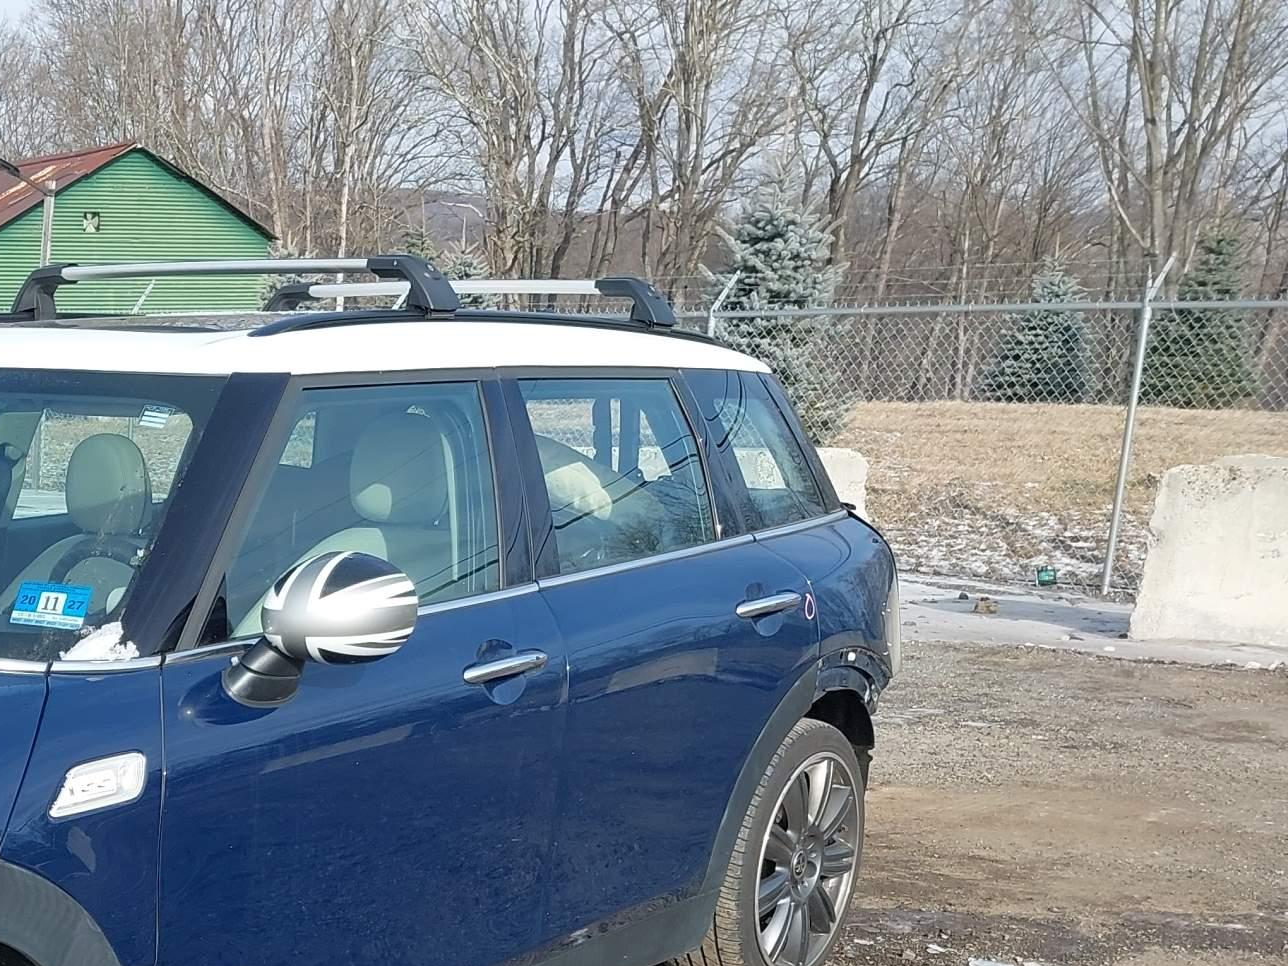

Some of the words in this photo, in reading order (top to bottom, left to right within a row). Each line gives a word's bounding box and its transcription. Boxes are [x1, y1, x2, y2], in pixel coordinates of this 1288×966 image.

[20, 594, 36, 605] 20
[41, 595, 59, 611] 11
[68, 600, 85, 610] 27
